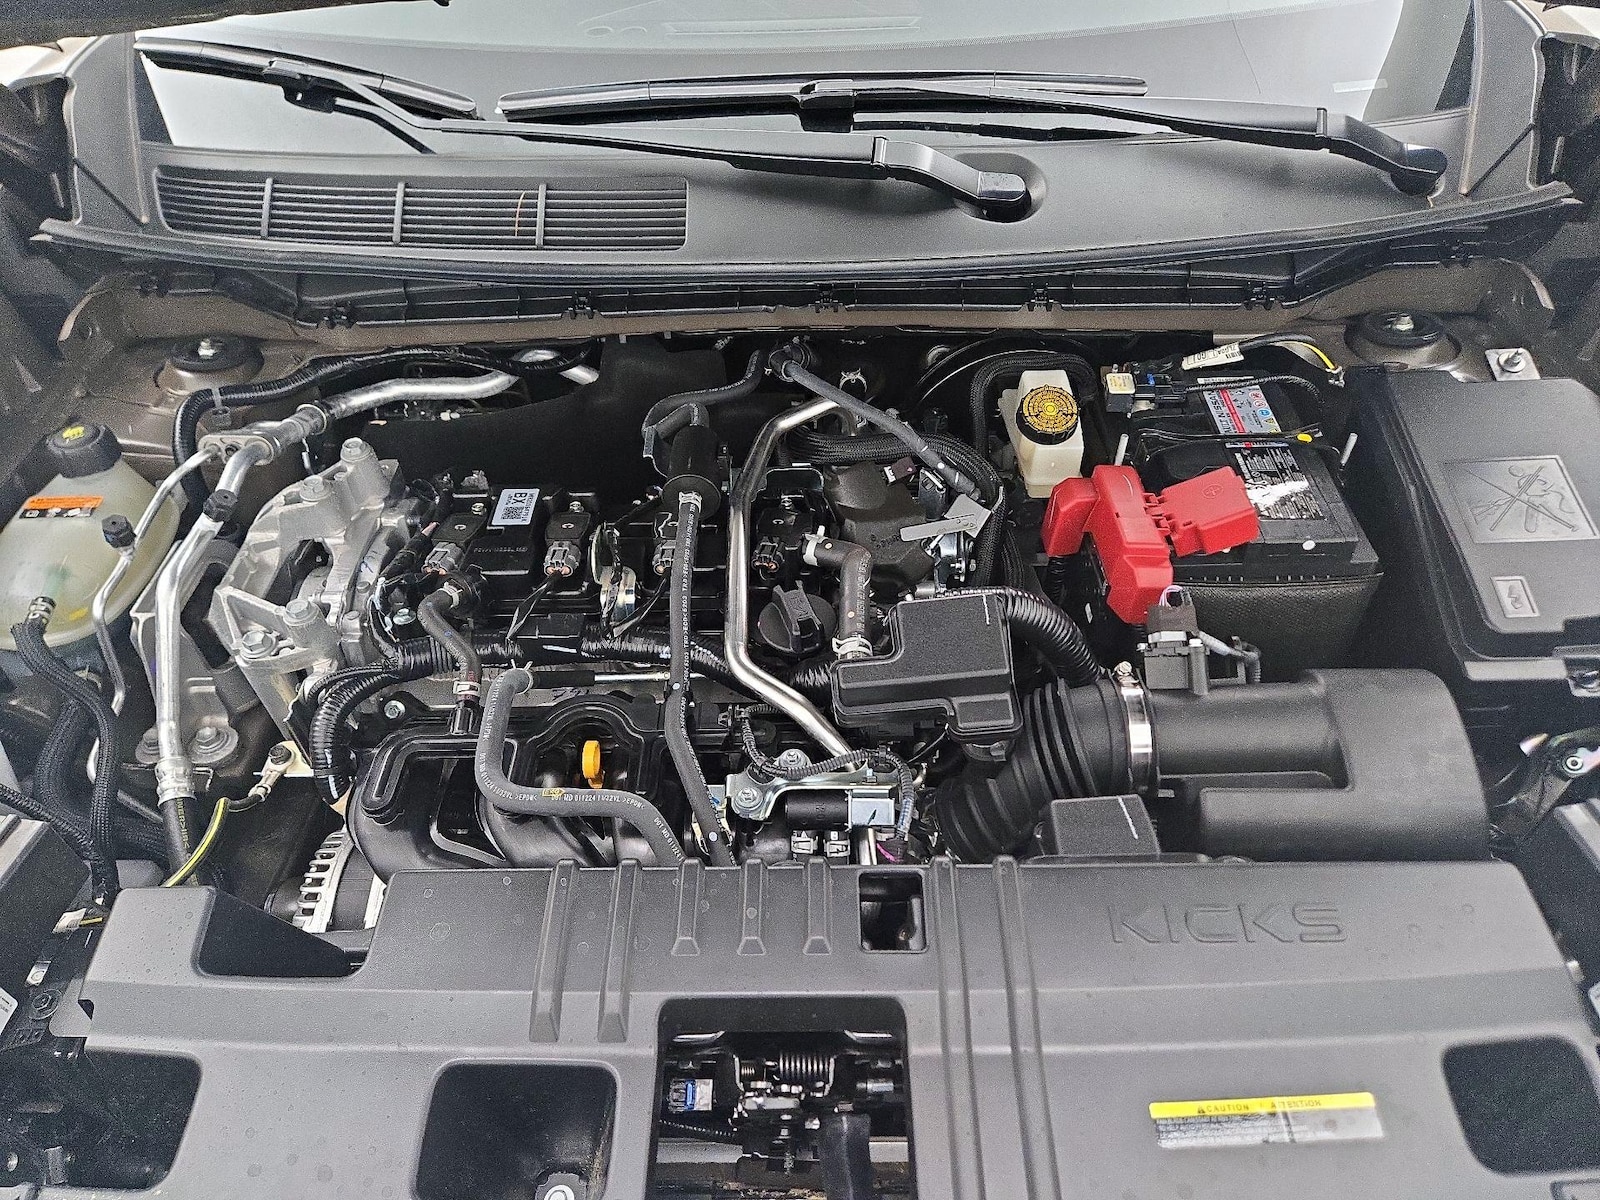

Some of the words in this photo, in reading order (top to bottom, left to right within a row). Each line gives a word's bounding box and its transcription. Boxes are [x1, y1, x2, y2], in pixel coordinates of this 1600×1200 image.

[512, 492, 528, 504] BX
[1107, 902, 1348, 943] KICKS
[1206, 1103, 1249, 1112] CAUTION
